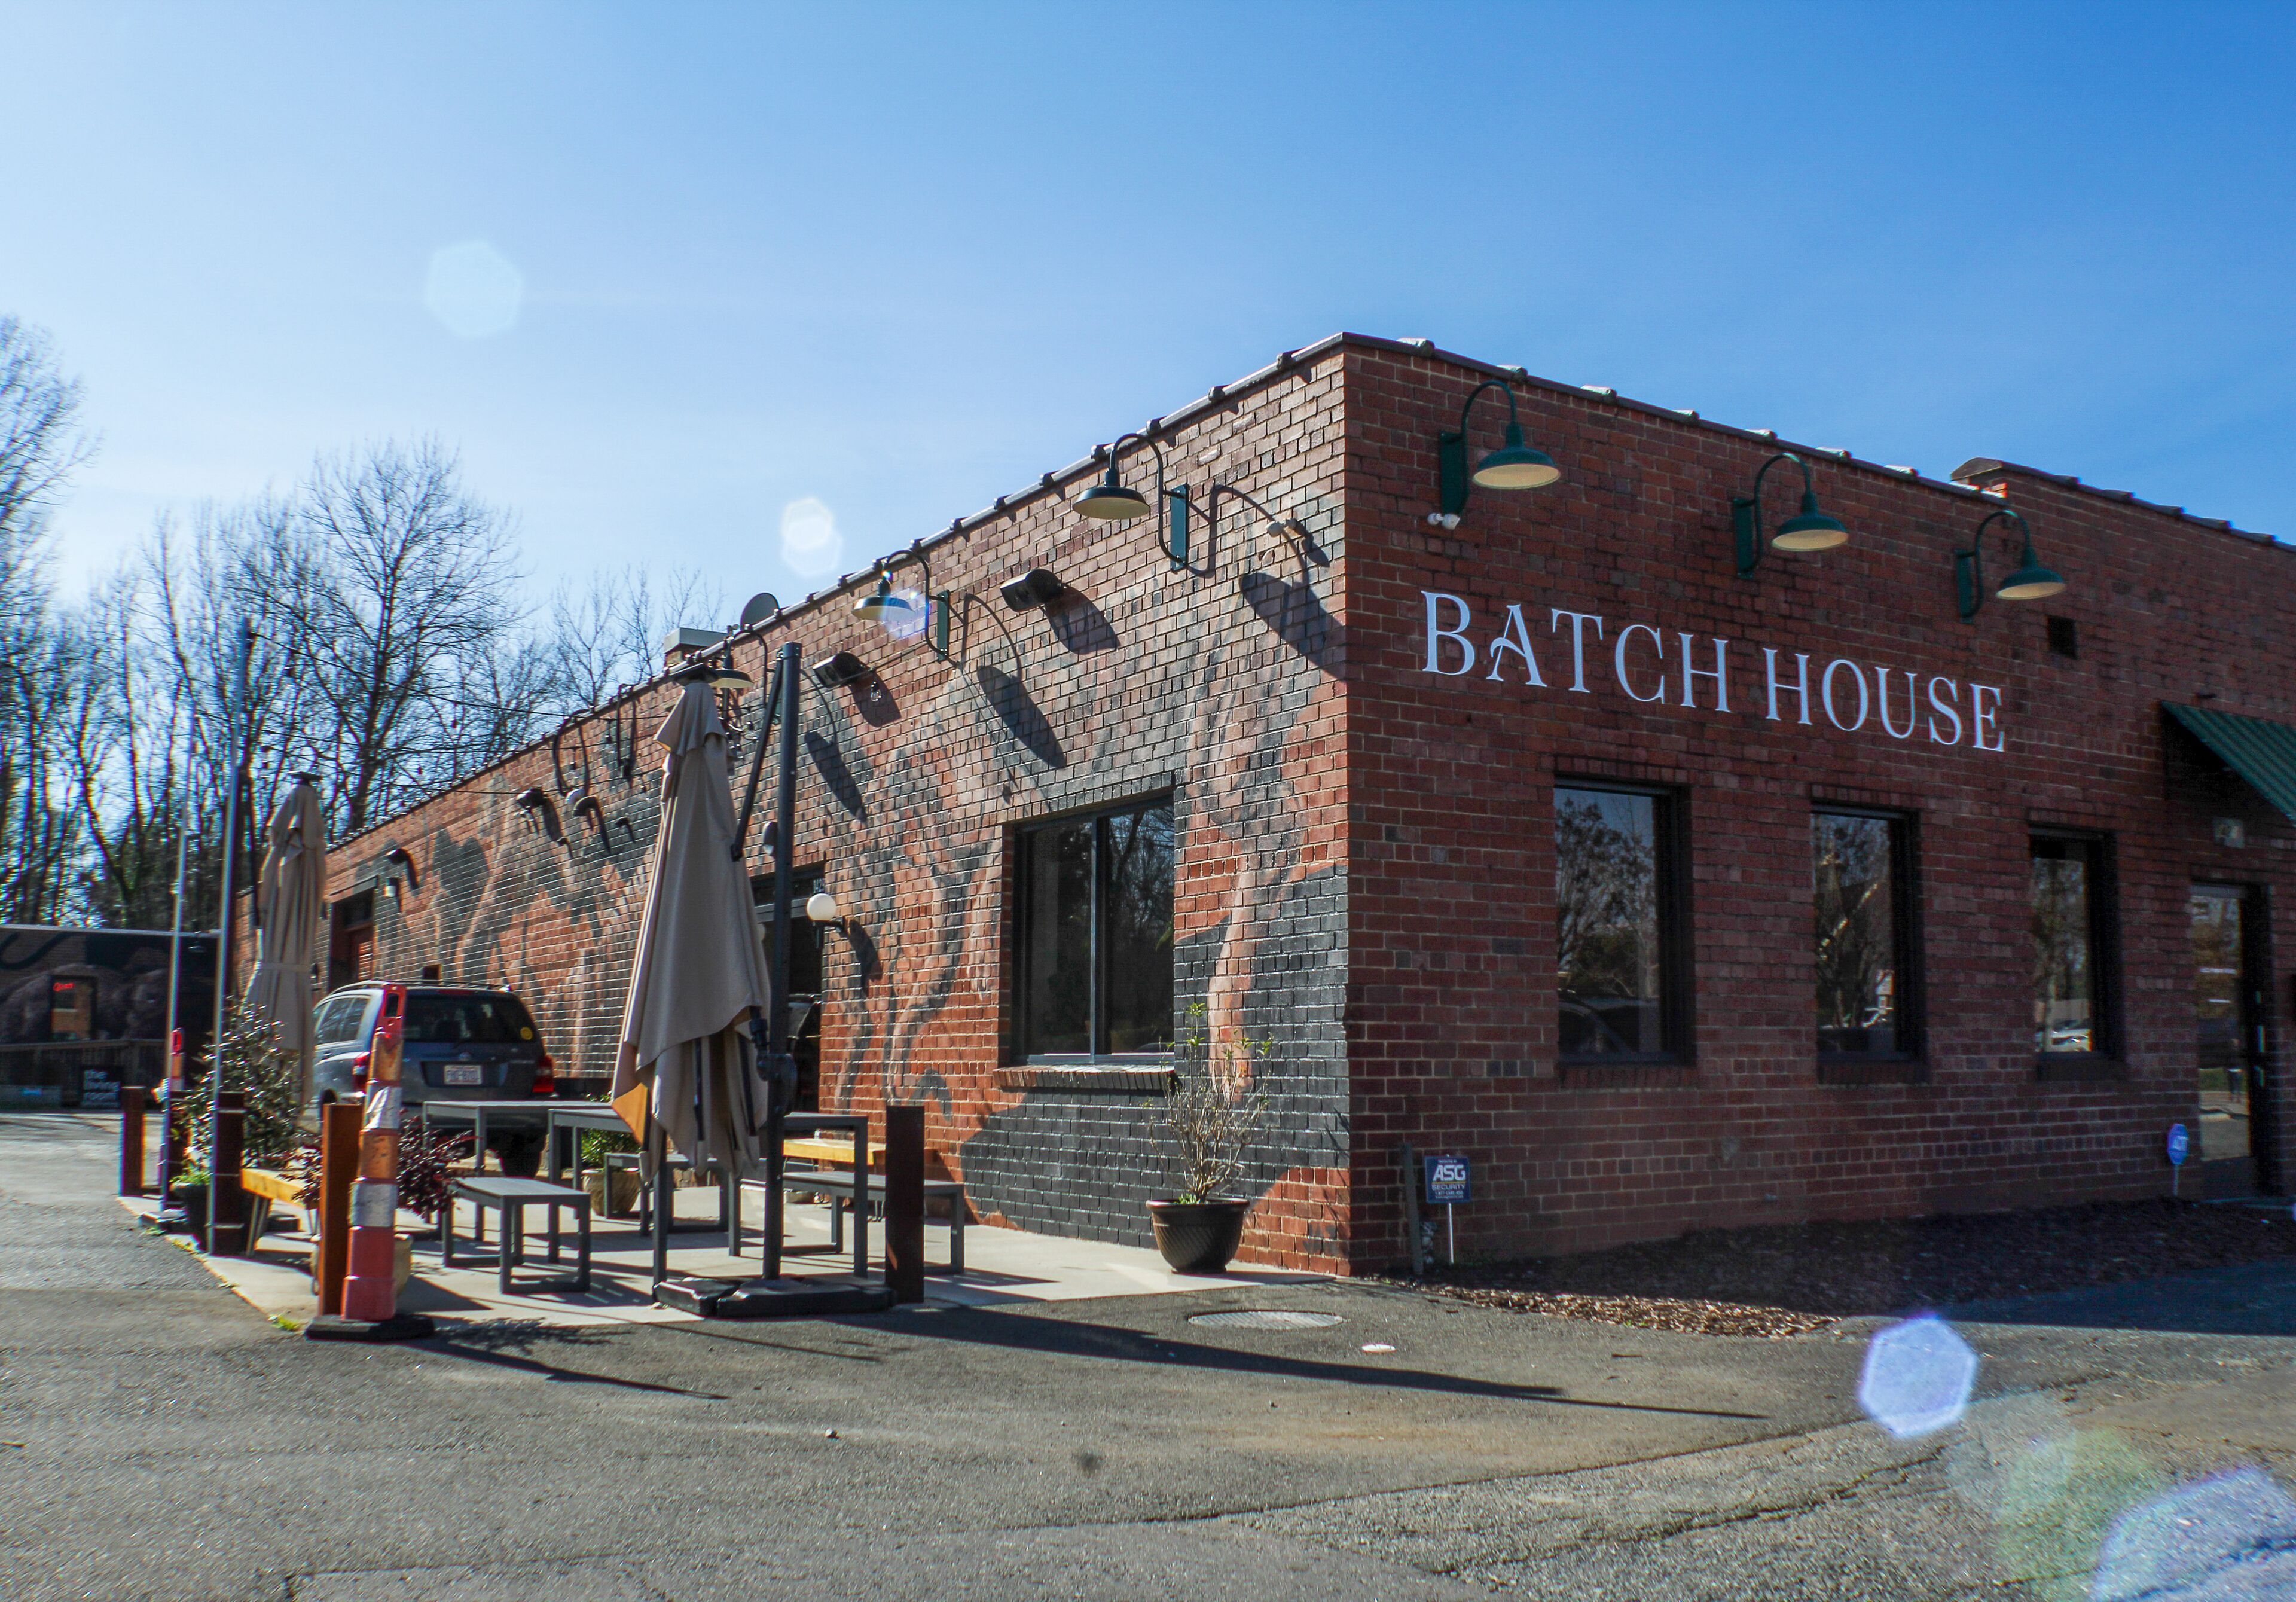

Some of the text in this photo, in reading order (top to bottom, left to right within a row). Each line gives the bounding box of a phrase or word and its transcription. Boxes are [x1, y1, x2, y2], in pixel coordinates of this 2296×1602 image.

[1421, 590, 2005, 753] BATCH HOUSE
[1433, 1164, 1466, 1182] ASG
